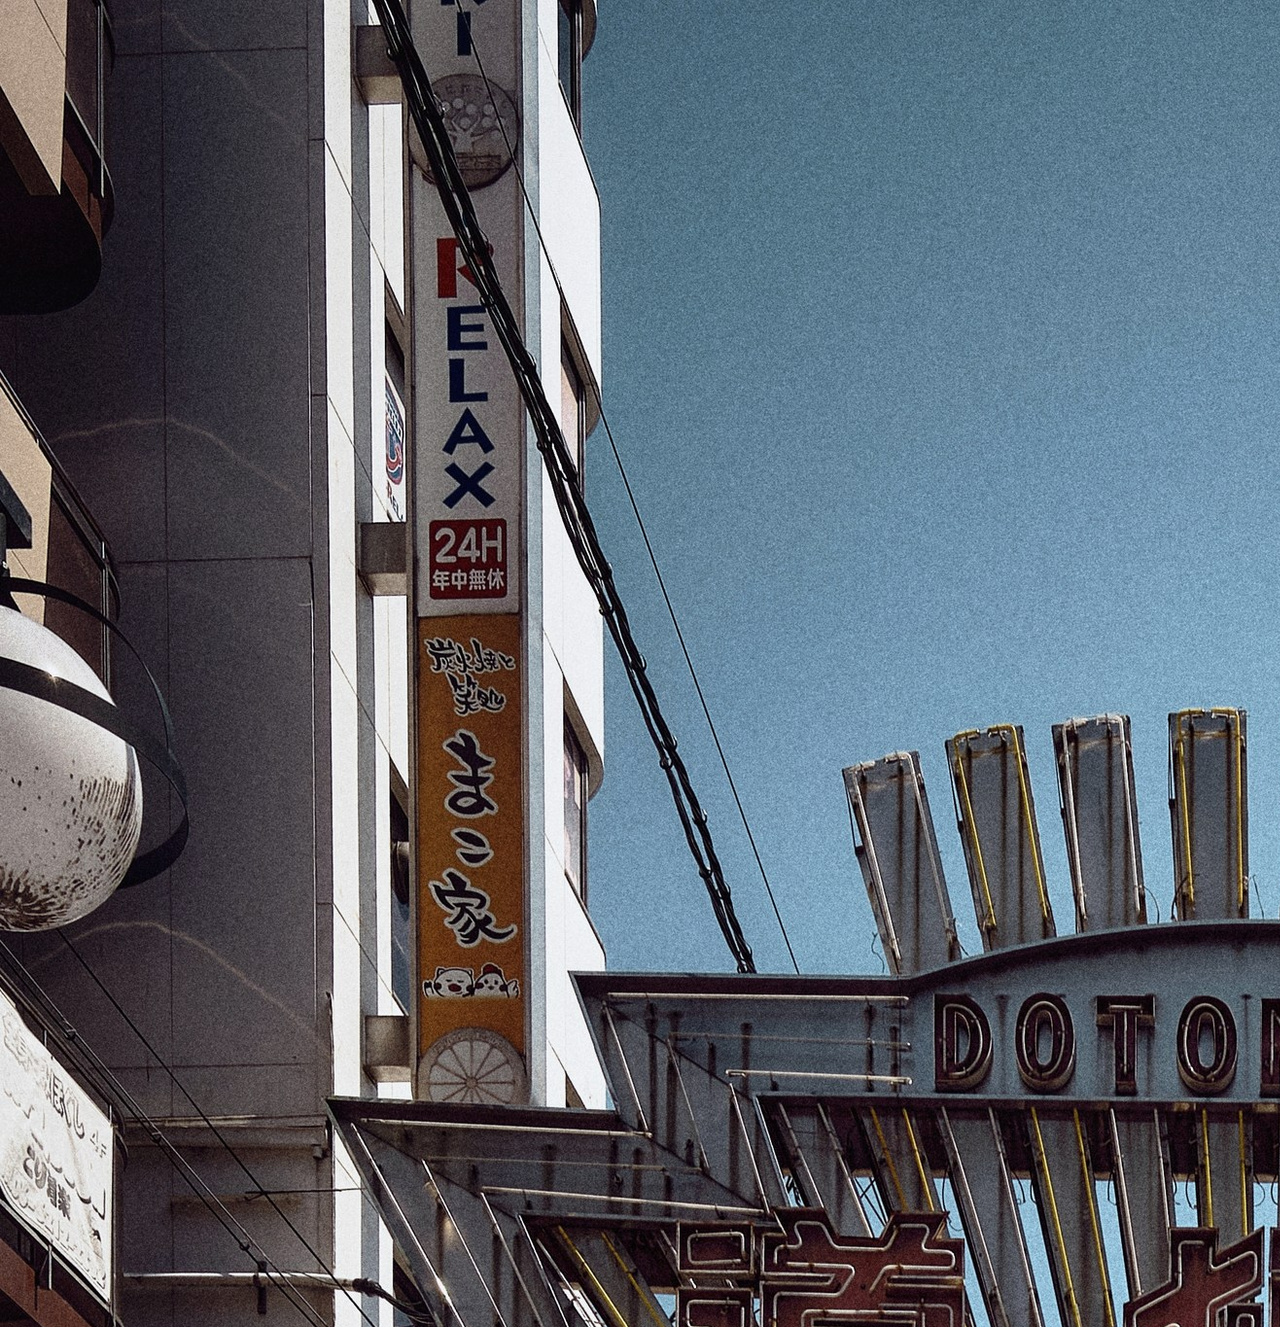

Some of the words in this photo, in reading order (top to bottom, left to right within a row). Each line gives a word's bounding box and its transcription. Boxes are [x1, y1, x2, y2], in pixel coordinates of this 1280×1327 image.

[437, 238, 495, 510] RELAX
[432, 569, 505, 593] 年中無休
[433, 527, 504, 565] 24H
[430, 730, 517, 946] まこ家
